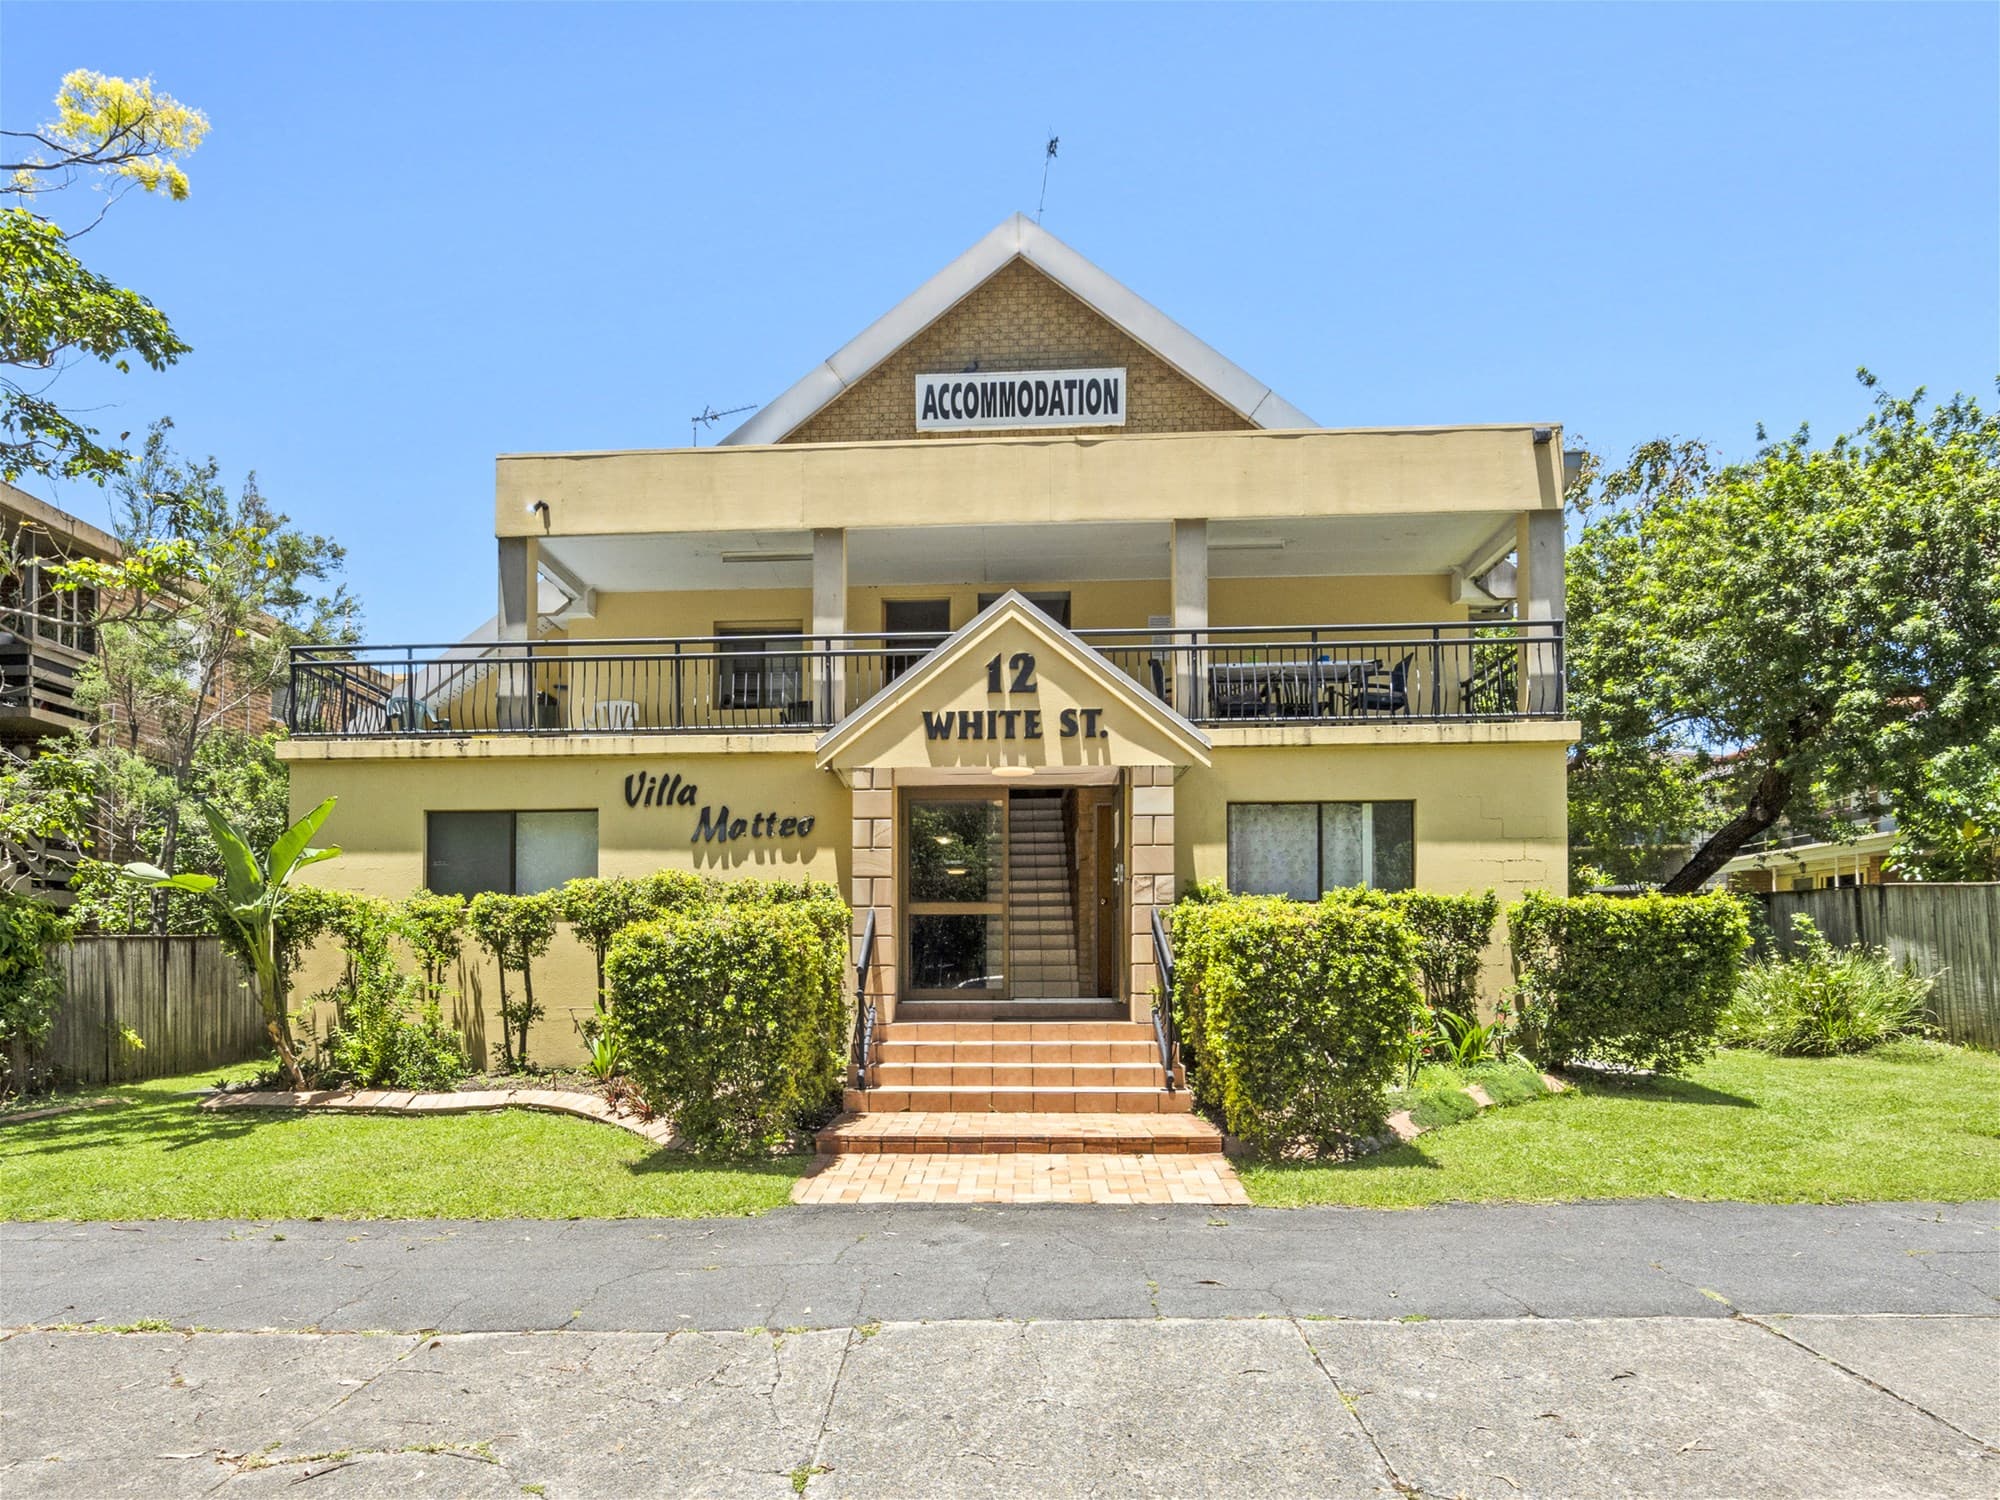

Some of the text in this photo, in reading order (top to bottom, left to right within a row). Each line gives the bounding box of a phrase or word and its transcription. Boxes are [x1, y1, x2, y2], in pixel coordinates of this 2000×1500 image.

[922, 378, 1119, 420] ACCOMMODATION
[986, 652, 1038, 693] 12
[922, 708, 1109, 740] WHITE ST.
[624, 771, 698, 808] Villa
[691, 805, 815, 843] Matteo
